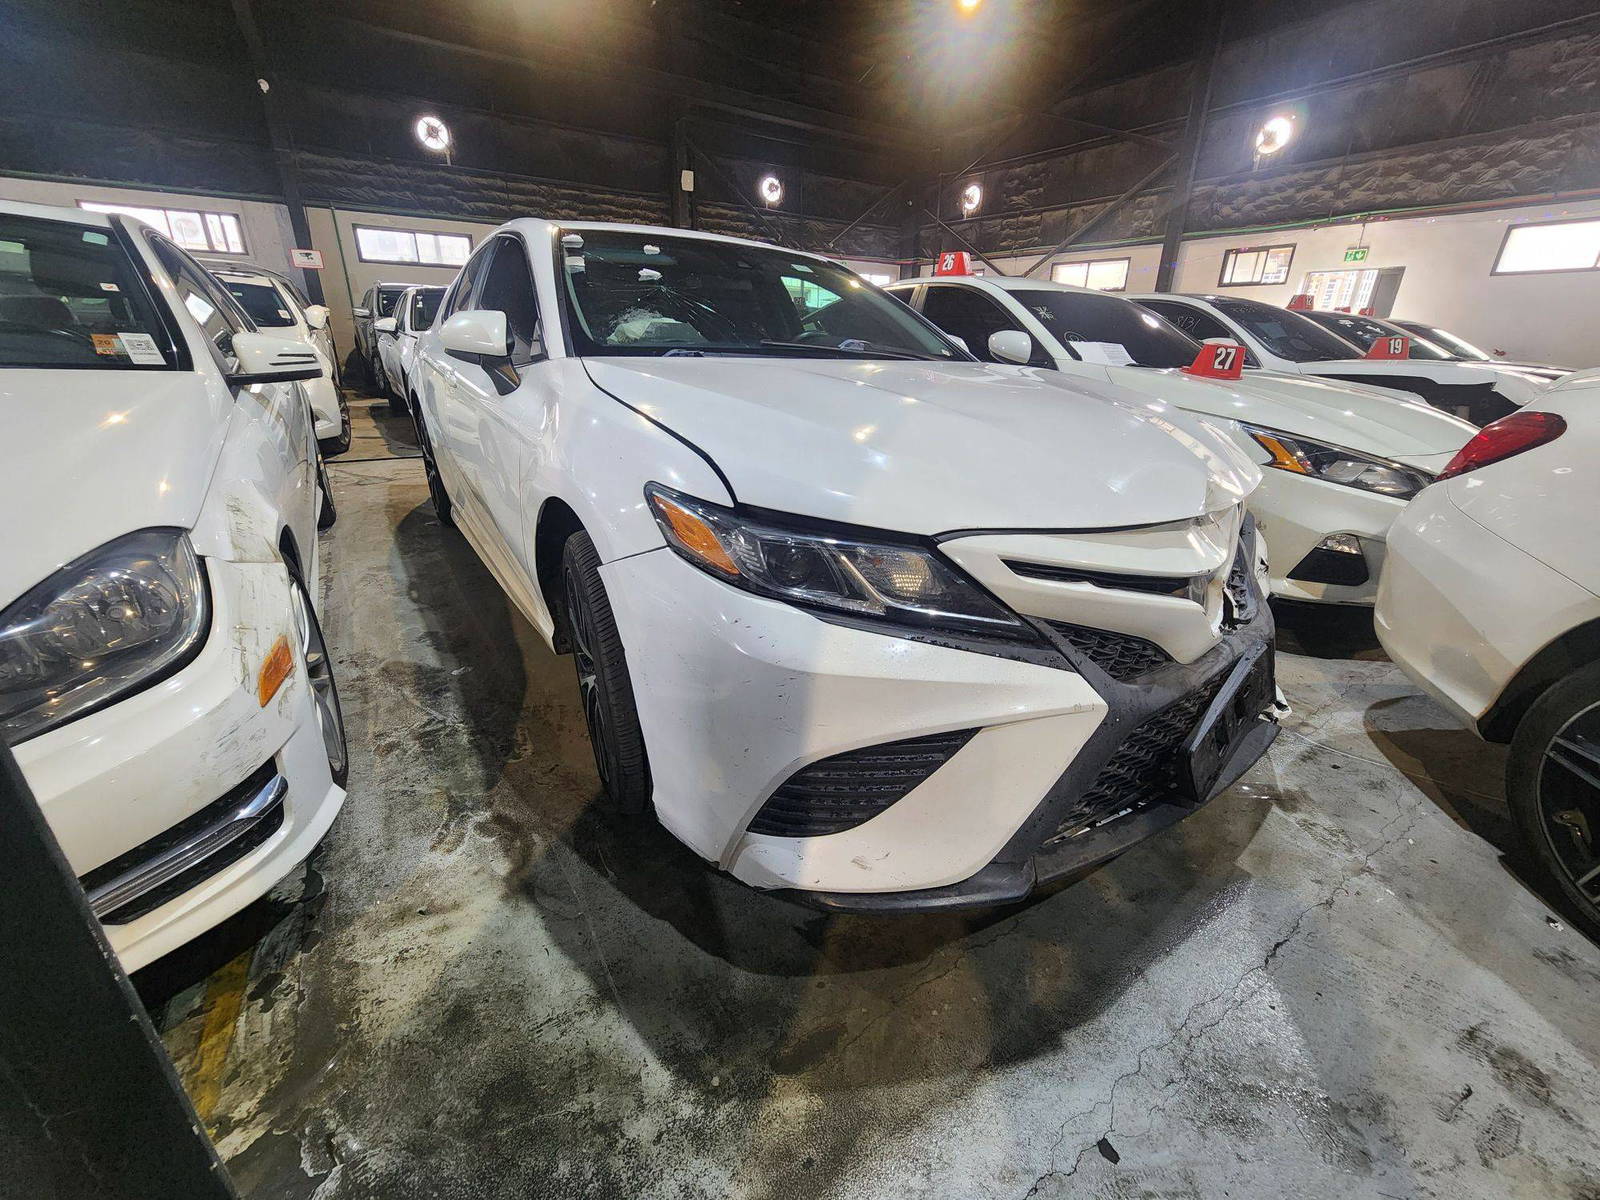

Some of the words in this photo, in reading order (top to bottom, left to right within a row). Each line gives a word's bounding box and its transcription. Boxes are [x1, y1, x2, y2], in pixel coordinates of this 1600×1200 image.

[942, 254, 955, 271] 26
[1389, 338, 1403, 354] 19
[1213, 347, 1236, 370] 27
